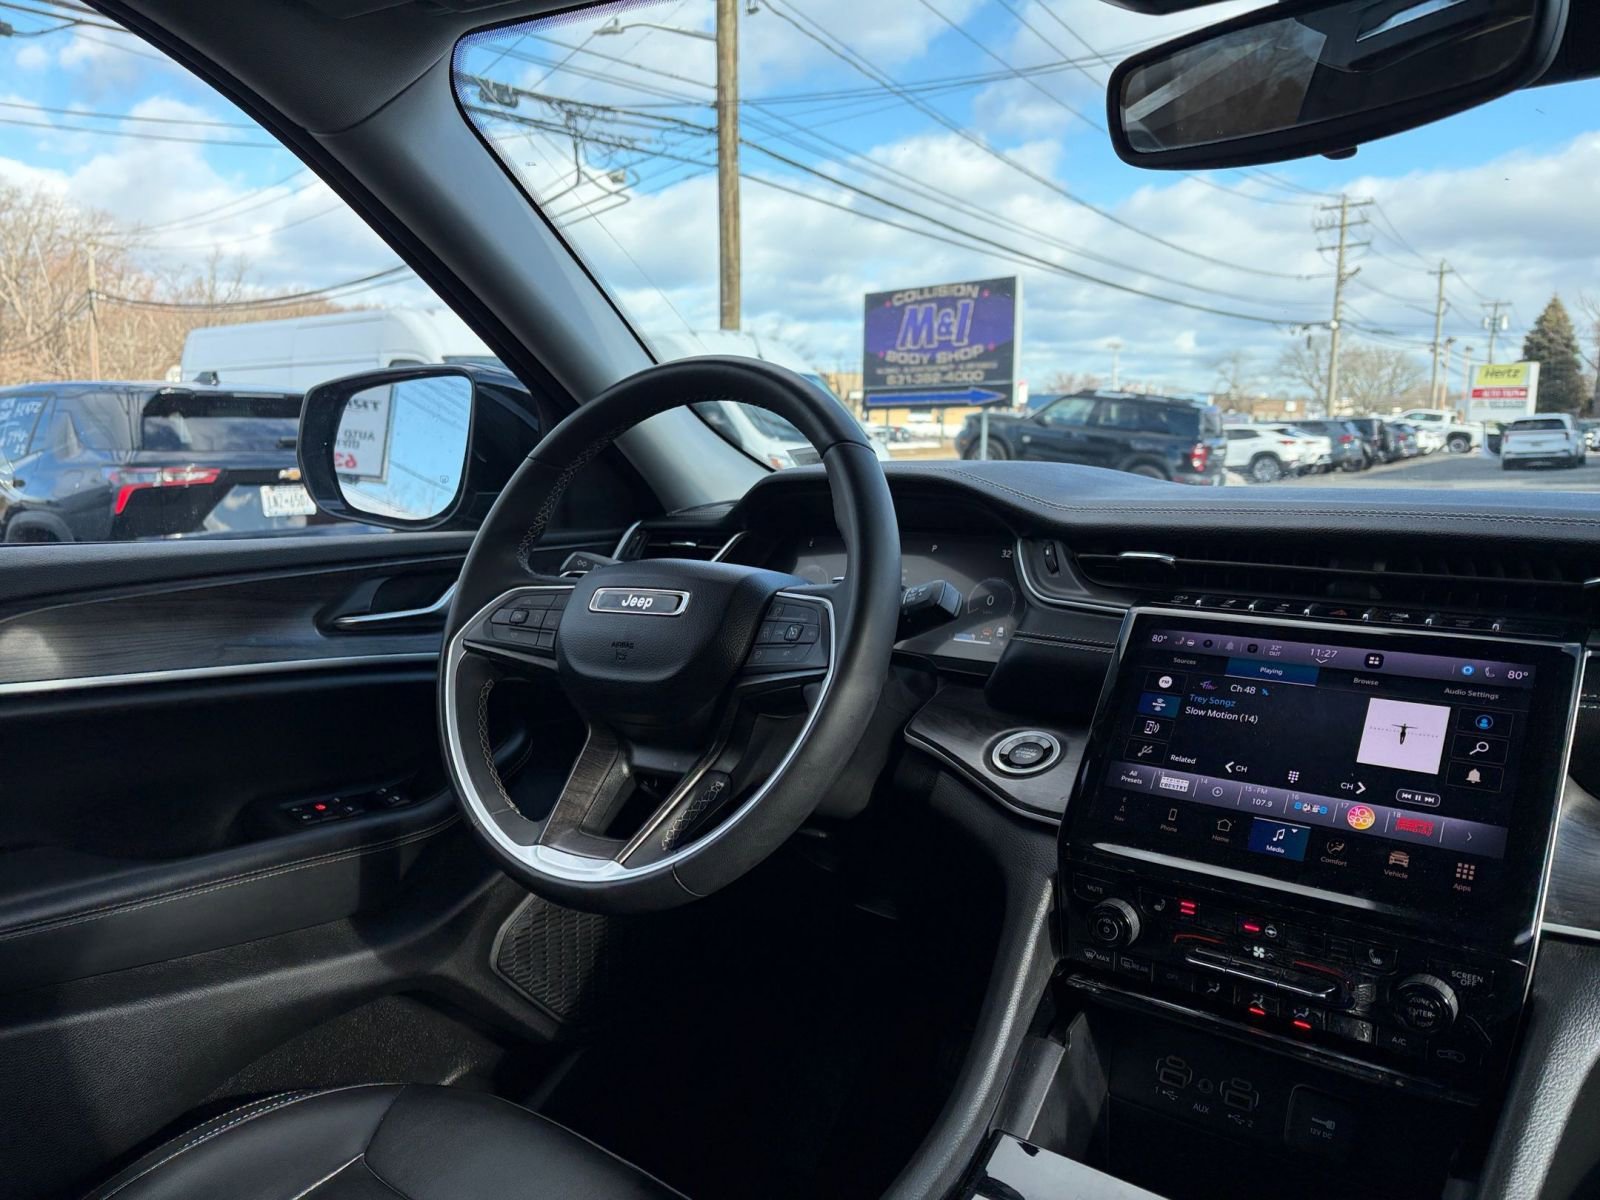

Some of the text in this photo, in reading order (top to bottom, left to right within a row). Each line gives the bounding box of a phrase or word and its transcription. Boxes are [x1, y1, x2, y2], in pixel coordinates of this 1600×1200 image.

[892, 284, 980, 306] COLLISION
[896, 299, 975, 350] M&I
[885, 344, 984, 364] BODY SHOP
[1484, 367, 1520, 379] Hertz
[621, 593, 654, 610] Jeep
[1309, 648, 1338, 659] 11:27
[1173, 656, 1197, 666] Sources
[1259, 666, 1283, 676] Playing
[1507, 669, 1529, 681] 80°
[1353, 676, 1379, 687] Browse
[1230, 684, 1256, 695] Ch 48
[1444, 687, 1500, 701] Audio Settings
[1189, 694, 1238, 708] Trey Songz
[1185, 705, 1259, 724] Slow Motion (14)
[1170, 753, 1197, 765] Related
[1235, 764, 1248, 774] CH
[1120, 775, 1143, 785] Presets
[1340, 782, 1354, 790] CH
[1252, 797, 1273, 808] 107.9
[1266, 844, 1285, 854] Media
[1320, 855, 1347, 867] Comfort
[1383, 868, 1409, 879] Vehicle
[1087, 884, 1104, 895] MUTE
[1453, 882, 1472, 893] Apps
[1096, 953, 1110, 963] MAX
[1451, 970, 1484, 984] SCREEN
[1460, 979, 1477, 988] OFF
[1391, 1036, 1408, 1047] A/C
[1192, 1102, 1210, 1114] AUX
